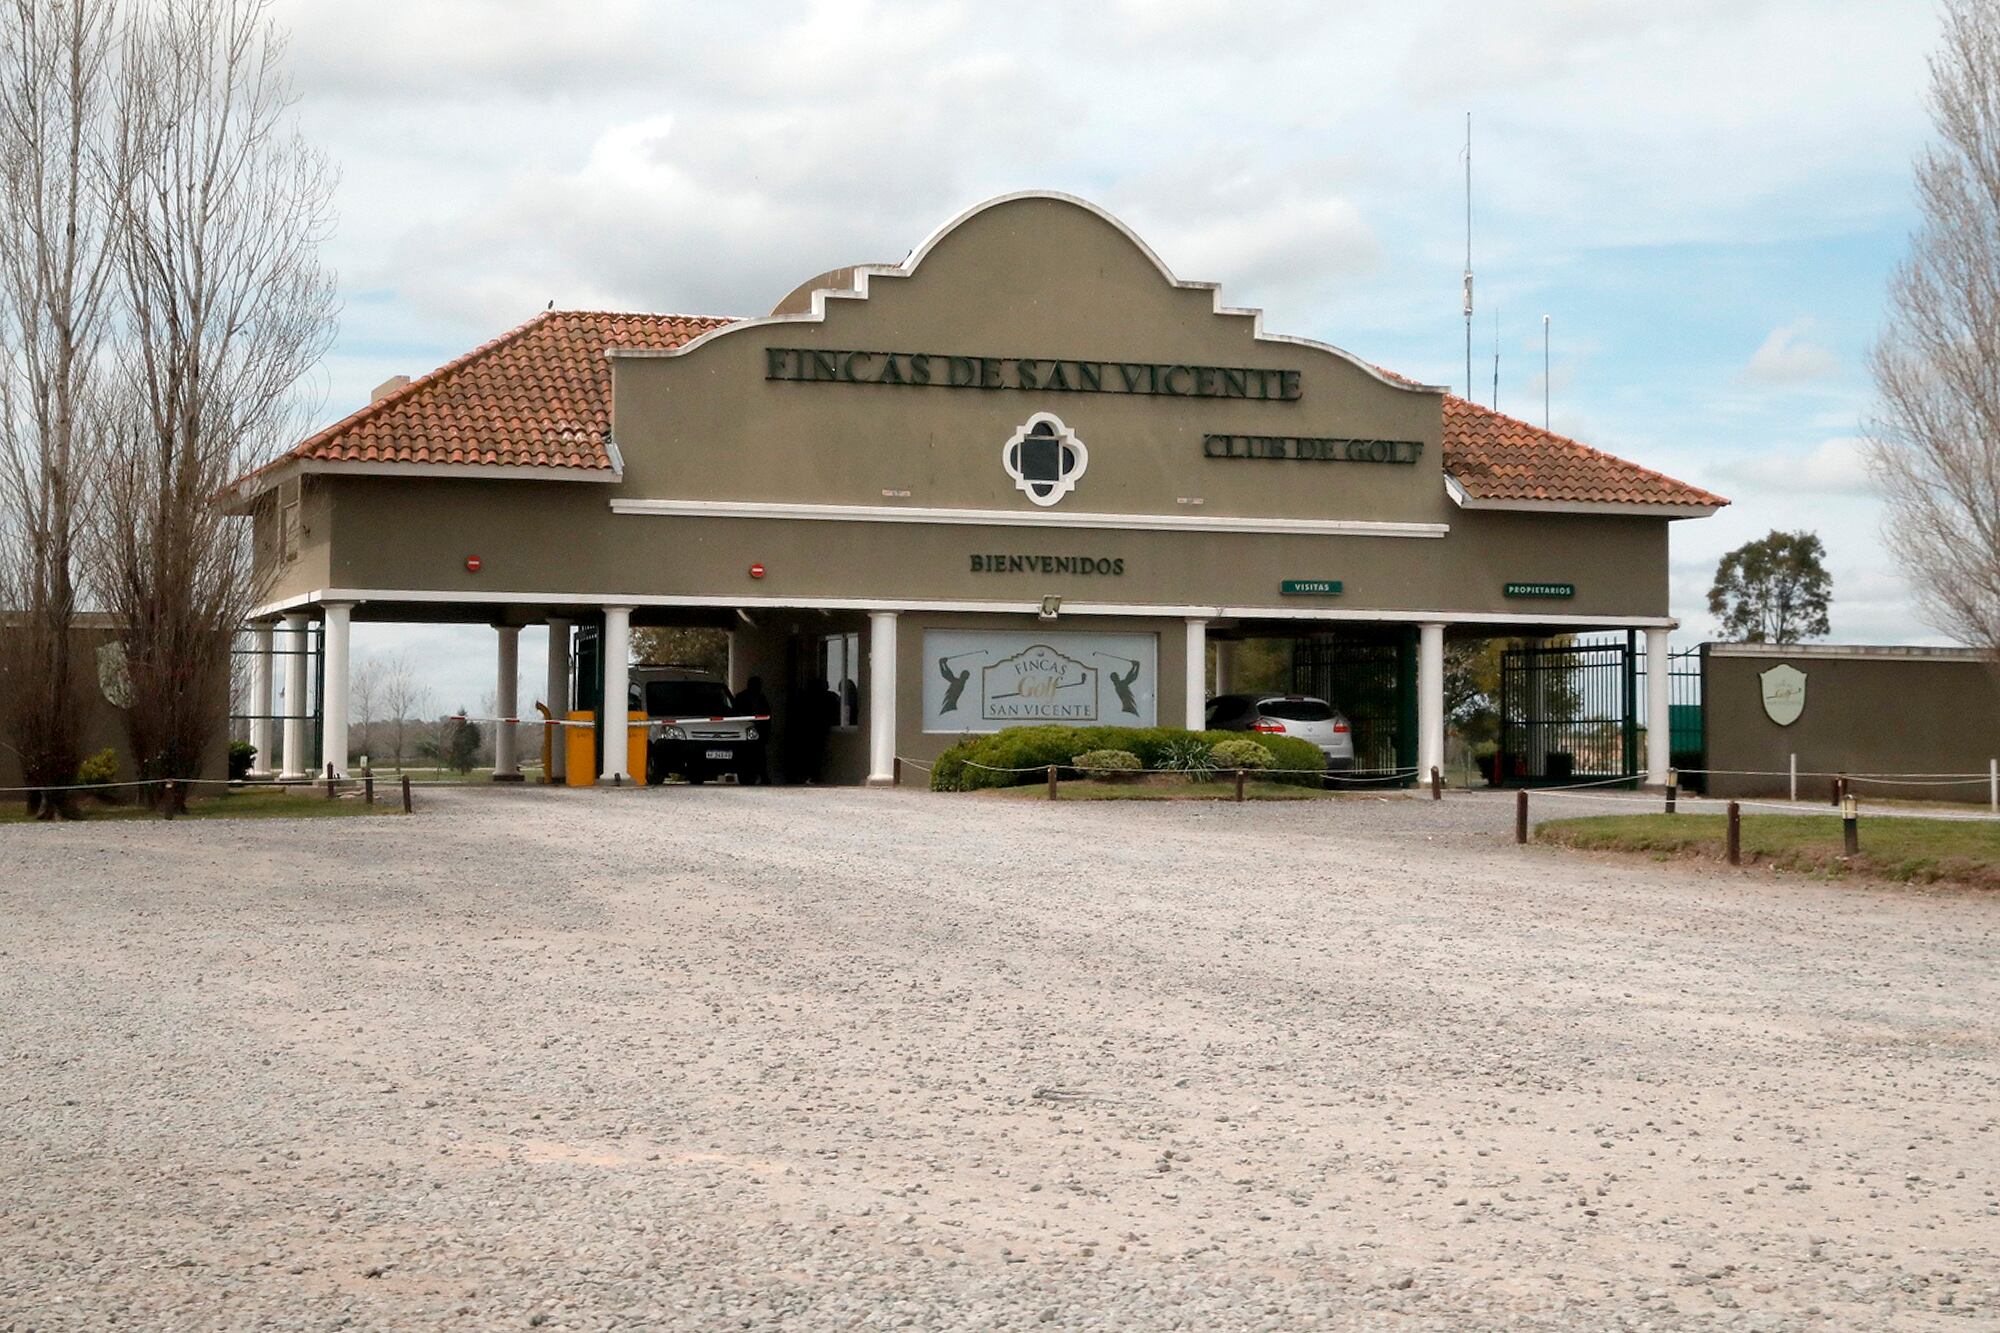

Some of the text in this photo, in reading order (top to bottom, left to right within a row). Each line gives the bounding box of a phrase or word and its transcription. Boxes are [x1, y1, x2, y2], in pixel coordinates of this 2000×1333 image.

[766, 348, 1303, 401] FINCAS DE SAN VICENTE
[1203, 434, 1425, 464] CLUB DE GOLF
[970, 554, 1125, 576] BIENVENIDOS
[1294, 583, 1330, 592] VISITAS
[1508, 586, 1571, 595] PROPIETARIOS
[1014, 659, 1068, 676] FINCAS
[1017, 675, 1063, 699] Golf
[989, 703, 1091, 717] SAN VICENTE
